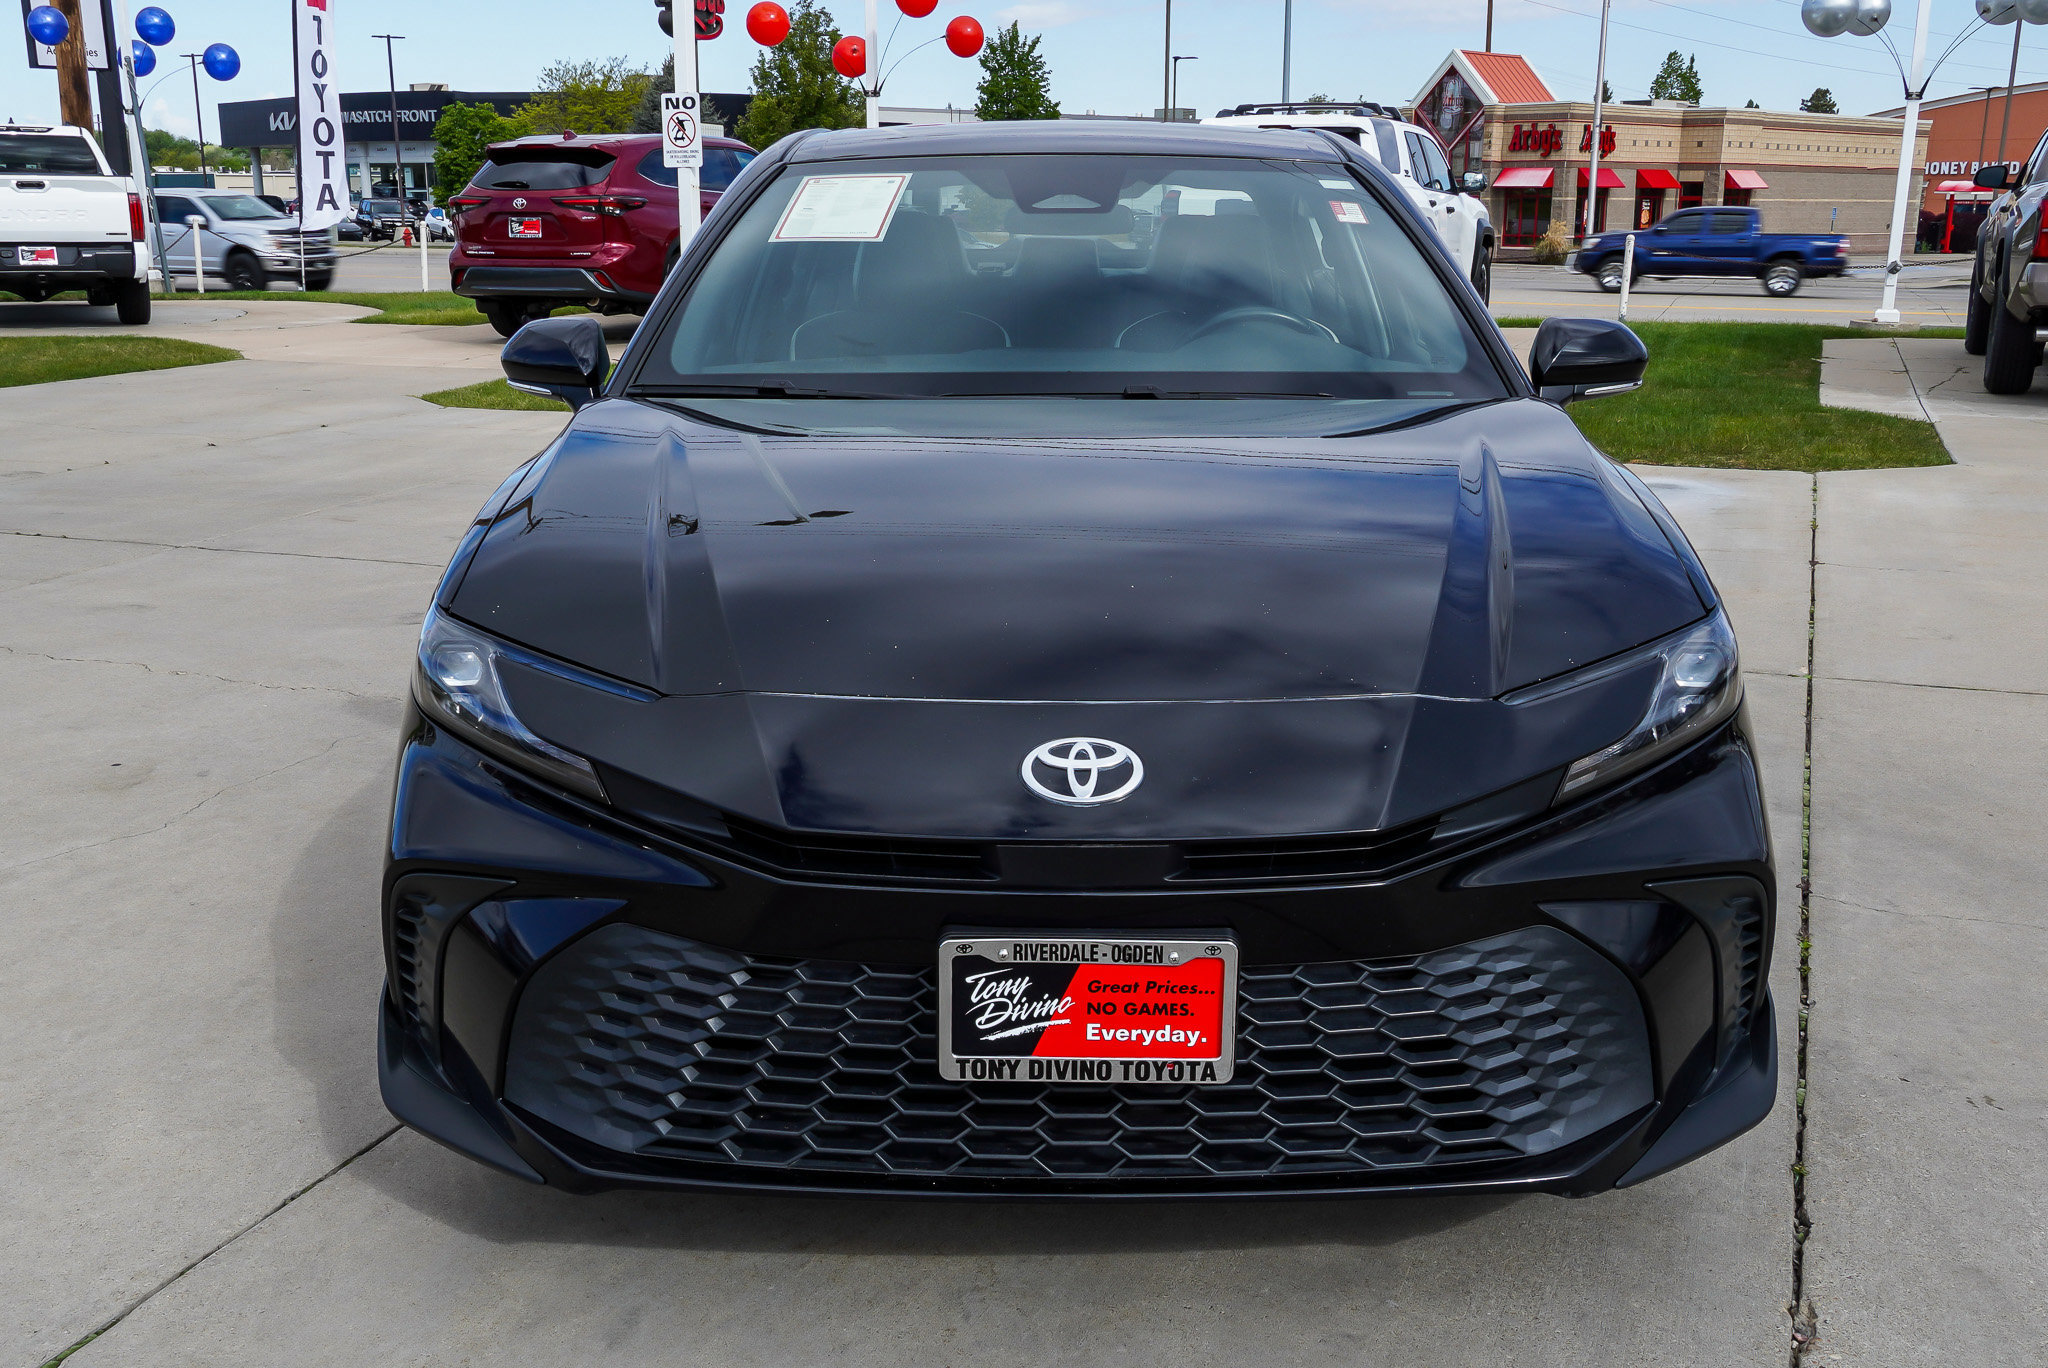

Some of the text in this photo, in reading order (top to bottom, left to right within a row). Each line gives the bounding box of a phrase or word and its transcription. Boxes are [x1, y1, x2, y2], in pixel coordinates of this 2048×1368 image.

[311, 14, 341, 212] TOYOTA
[665, 96, 696, 110] NO
[341, 110, 392, 123] WASATCH
[395, 109, 438, 123] FRONT
[1508, 123, 1563, 157] Arby's
[1579, 124, 1617, 159] Ay's
[1013, 943, 1099, 962] RIVERDALE
[1111, 945, 1164, 964] OGDEN
[965, 968, 1033, 1003] Tony
[1087, 979, 1216, 995] Great Prices...
[965, 994, 1076, 1030] Divino
[1086, 1002, 1195, 1017] NO GAMES.
[1086, 1023, 1207, 1047] Everyday.
[955, 1058, 1217, 1082] TONY DIVINO TOYOTA
